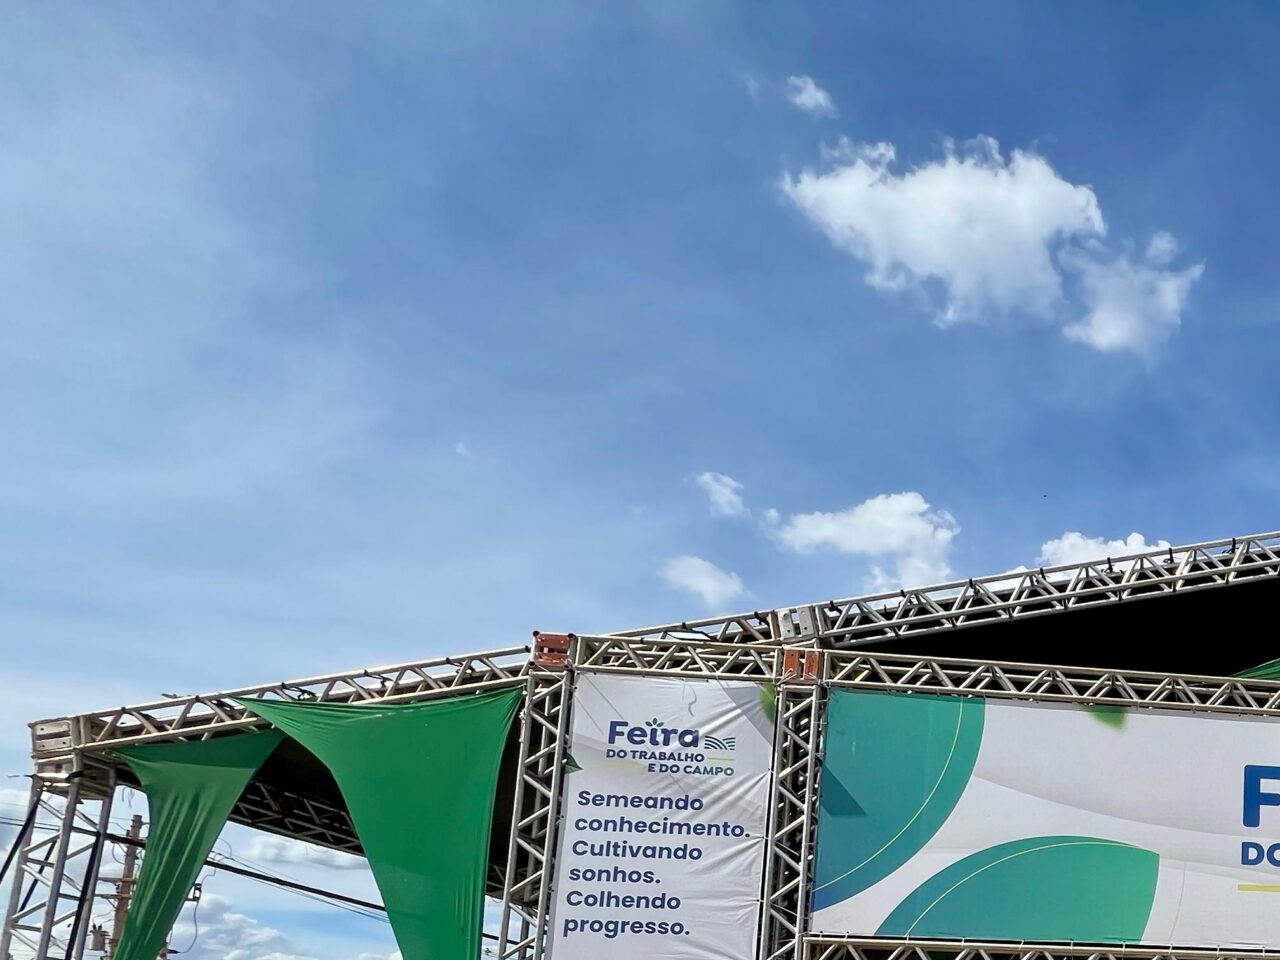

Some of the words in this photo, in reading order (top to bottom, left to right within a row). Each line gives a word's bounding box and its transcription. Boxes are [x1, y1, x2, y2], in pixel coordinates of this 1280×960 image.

[608, 718, 700, 748] Feira
[606, 749, 627, 759] DO
[630, 750, 705, 762] TRABALHO
[647, 763, 656, 773] E
[659, 764, 681, 774] DO
[683, 765, 735, 776] CAMPO
[577, 790, 704, 811] Semeando
[574, 816, 751, 838] conhecimento.
[571, 840, 703, 861] Cultivando
[568, 865, 661, 884] sonhos.
[566, 890, 681, 910] Colhendo
[562, 917, 690, 939] progresso.
